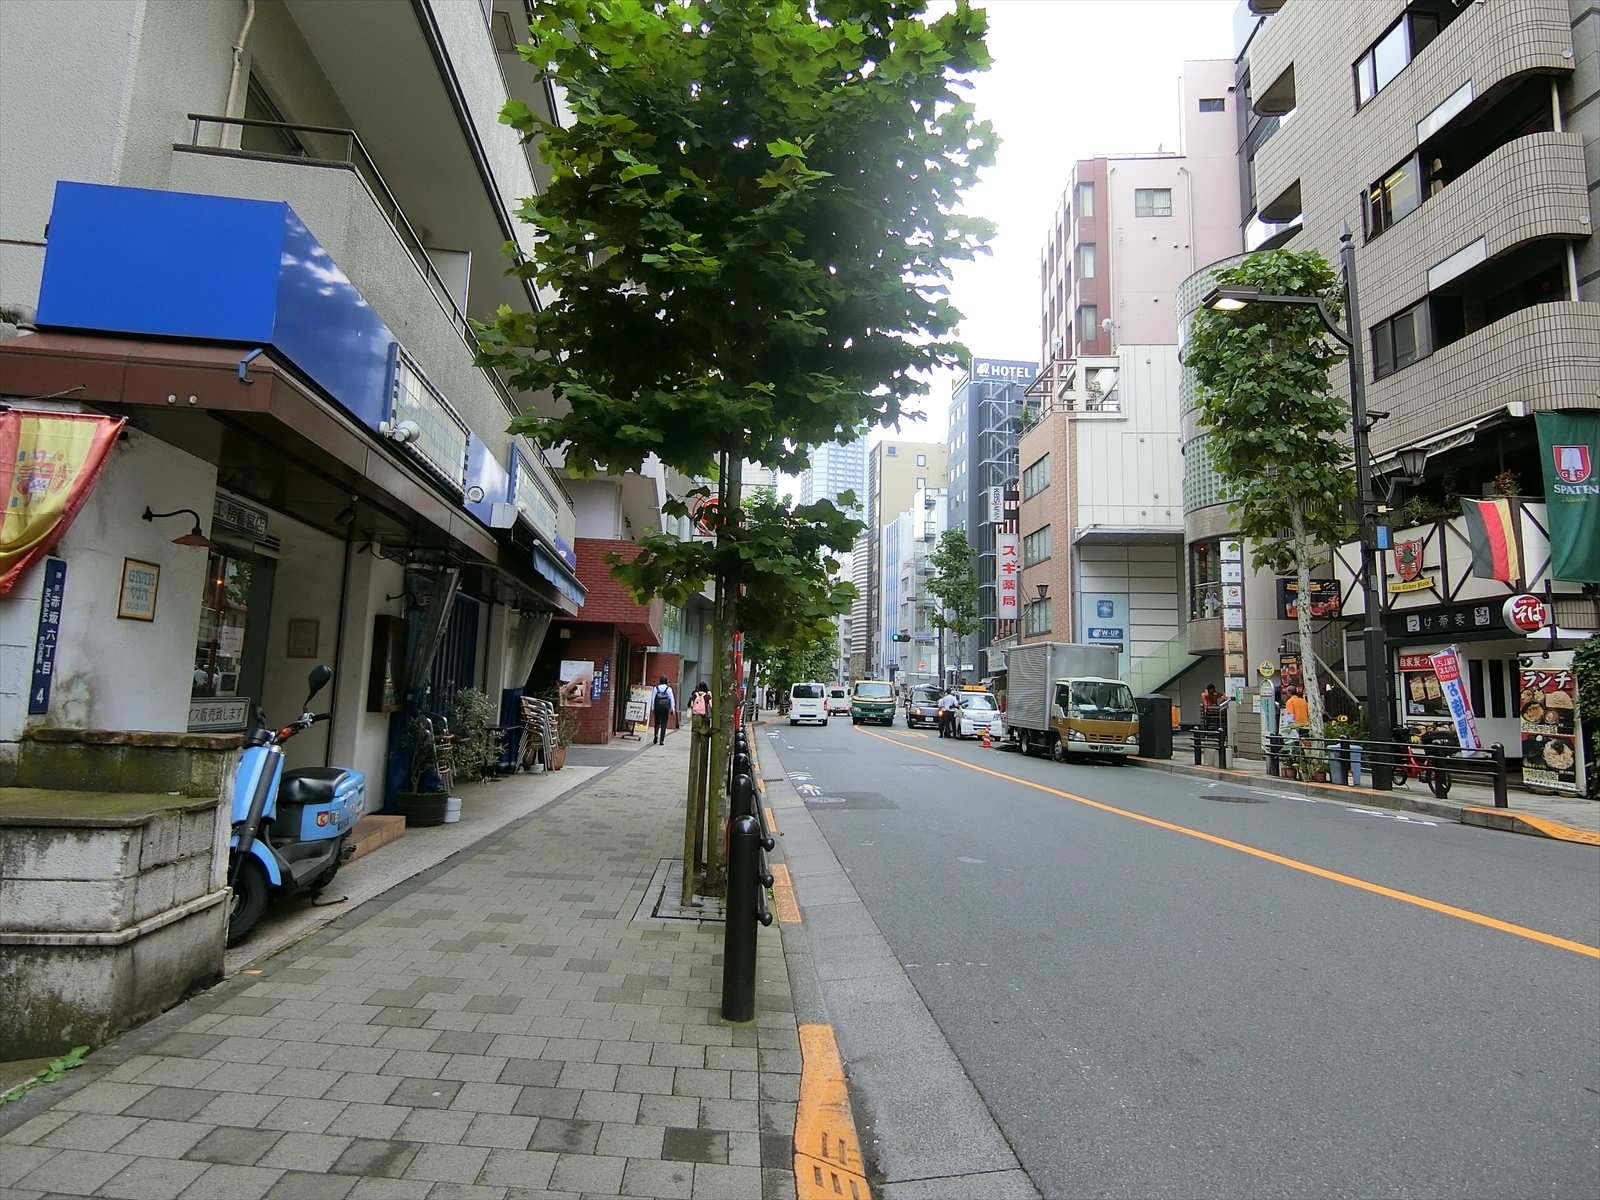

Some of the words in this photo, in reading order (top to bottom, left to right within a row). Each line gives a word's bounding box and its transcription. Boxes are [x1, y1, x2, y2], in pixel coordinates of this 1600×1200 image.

[991, 365, 1032, 378] HOTEL
[1002, 545, 1018, 607] スギ薬局
[41, 587, 52, 623] AKASAKA
[1513, 602, 1543, 624] そば
[1408, 612, 1466, 630] つけ蕎麦
[42, 595, 61, 675] 赤坂六丁目
[1522, 670, 1571, 690] ランチ
[36, 687, 44, 704] 4
